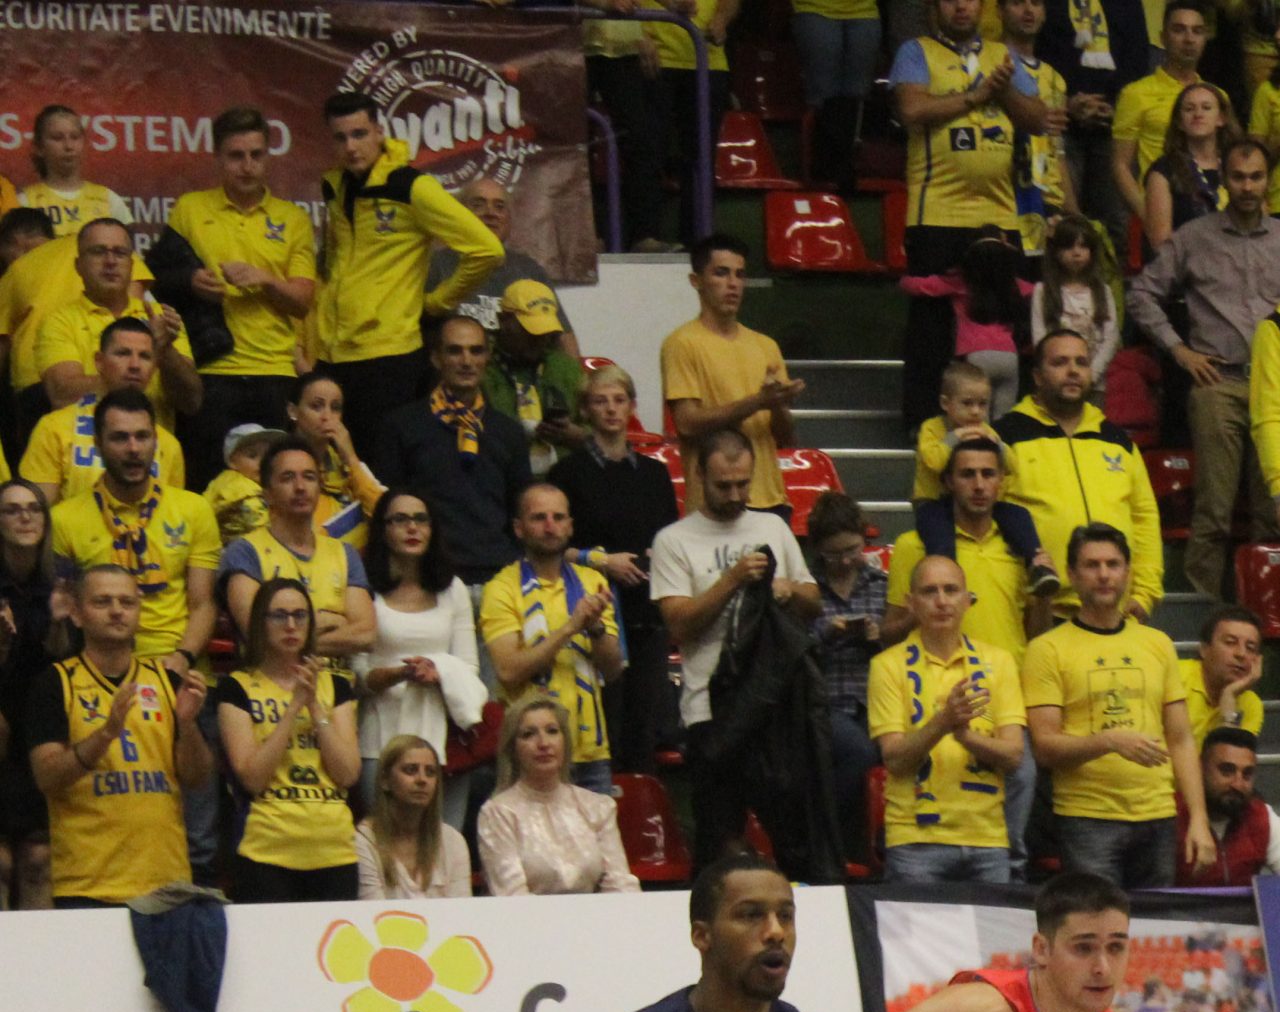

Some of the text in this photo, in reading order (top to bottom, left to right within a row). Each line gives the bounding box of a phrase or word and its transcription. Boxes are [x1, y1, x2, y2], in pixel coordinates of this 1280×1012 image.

[150, 4, 332, 40] EVENIMENTE
[391, 26, 418, 48] BY
[371, 58, 488, 106] HIGH QUALITY
[376, 79, 525, 161] vanti
[119, 728, 139, 762] 6
[93, 771, 129, 797] CSU
